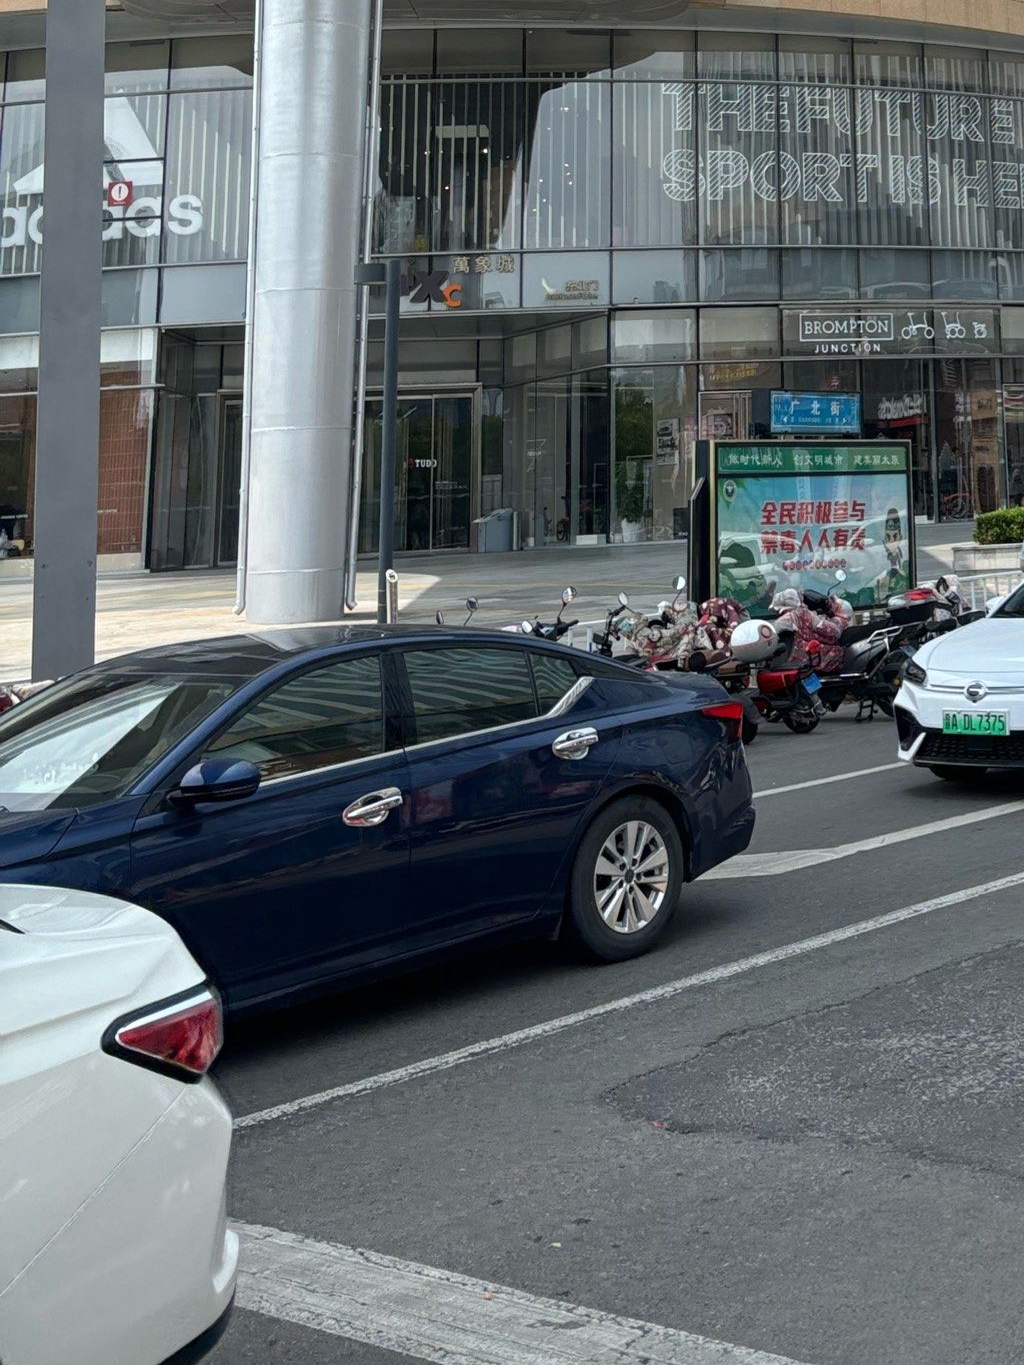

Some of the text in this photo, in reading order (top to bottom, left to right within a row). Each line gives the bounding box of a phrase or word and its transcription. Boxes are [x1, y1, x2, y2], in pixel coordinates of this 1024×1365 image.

[663, 83, 790, 133] THE
[797, 87, 1015, 144] FUTURE
[663, 148, 878, 203] SPORT
[890, 155, 942, 205] IS
[453, 255, 515, 273] 萬象城
[804, 319, 889, 334] BROMPTON
[815, 343, 881, 353] JUNCTION
[794, 454, 843, 466] 创文明城市
[761, 500, 866, 525] 全民积极参与
[761, 528, 866, 554] 禁毒人人有责
[963, 714, 1005, 731] DL7375
